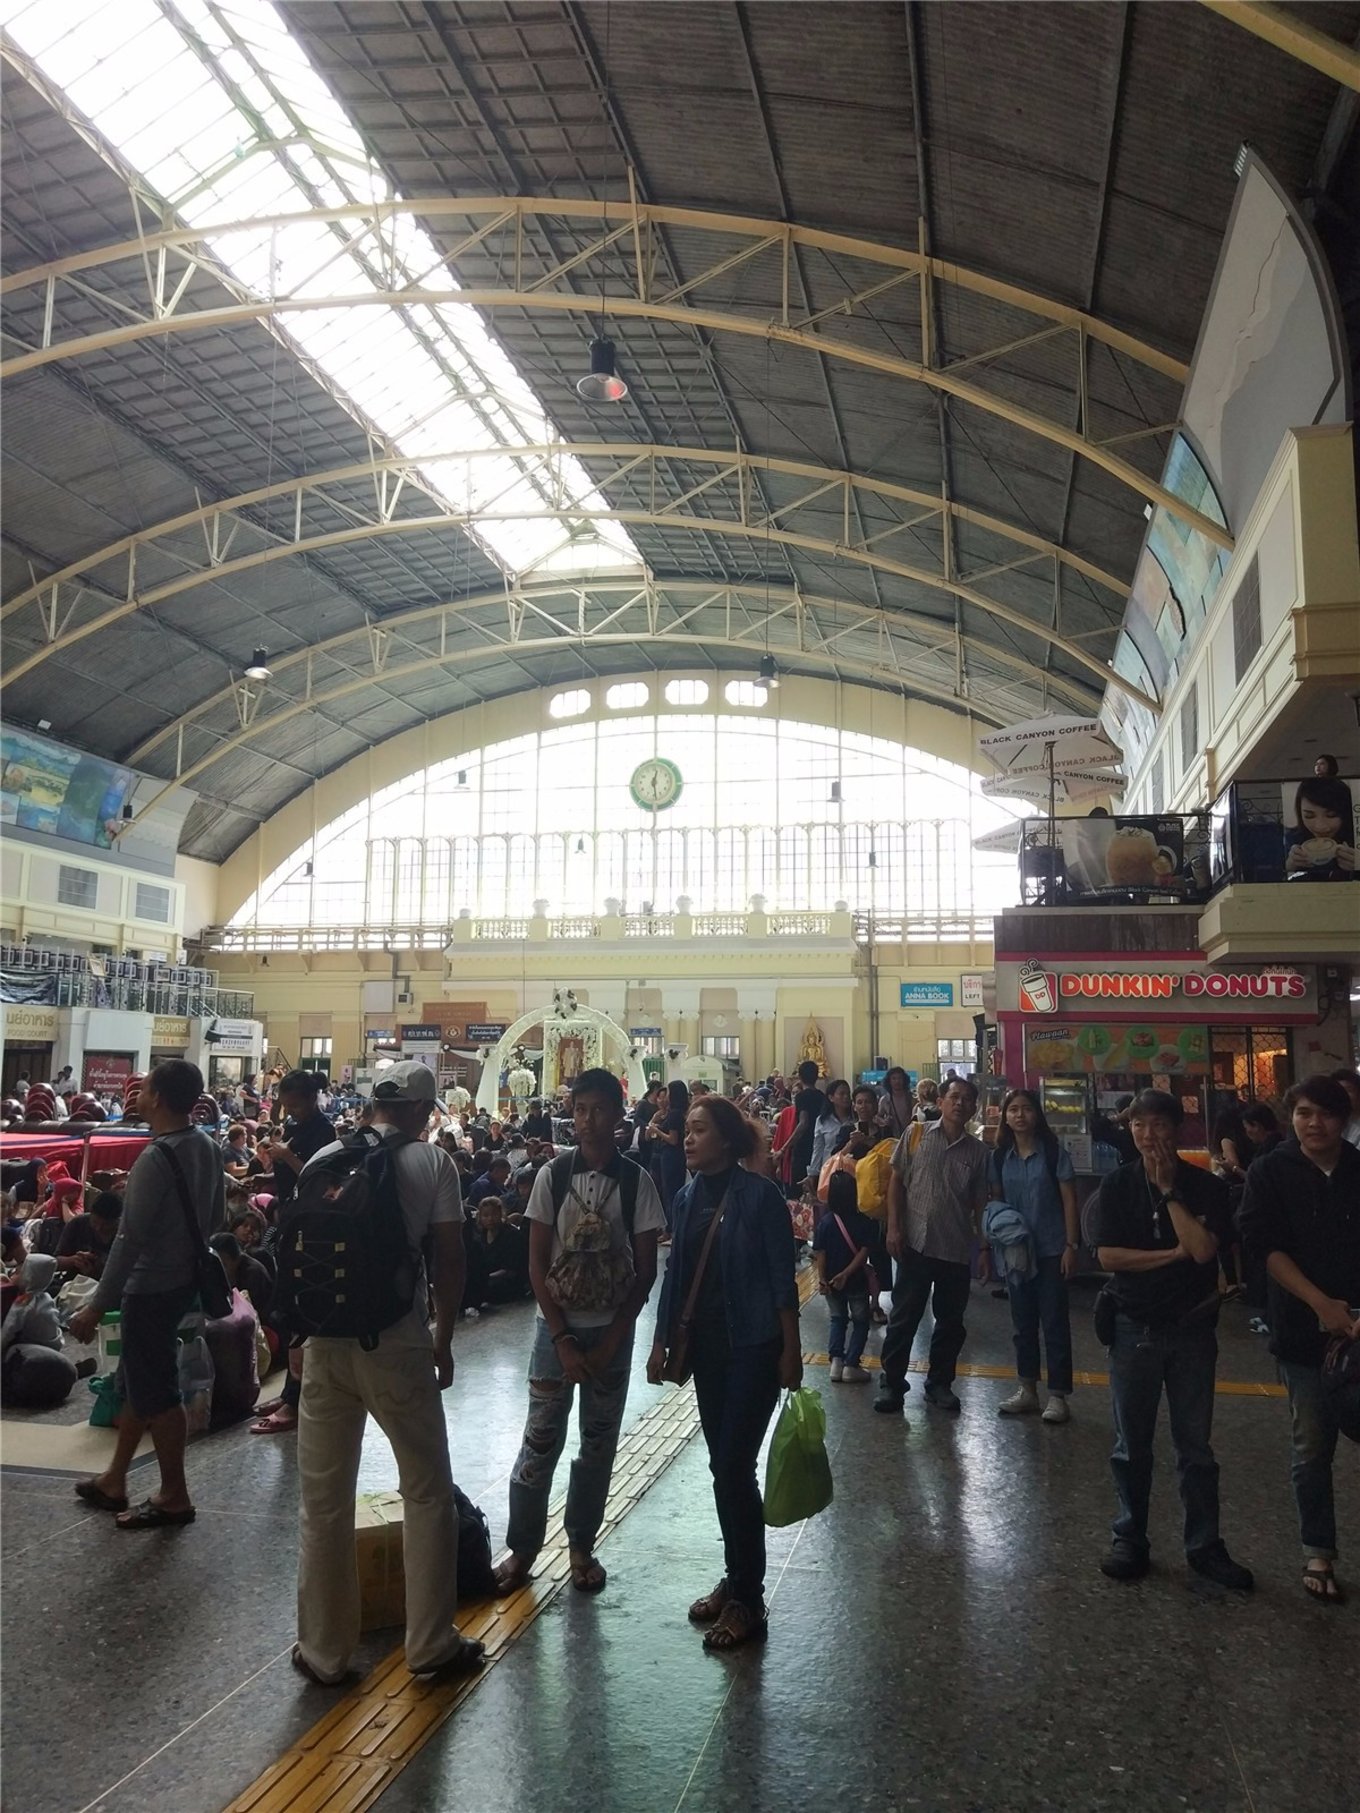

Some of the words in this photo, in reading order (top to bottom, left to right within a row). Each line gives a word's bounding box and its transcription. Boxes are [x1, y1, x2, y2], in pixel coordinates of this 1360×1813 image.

[980, 735, 1011, 745] BLACK
[1015, 729, 1055, 741] CANYON
[1058, 723, 1097, 735] COFFEE
[1063, 770, 1094, 780] CANYON
[1096, 775, 1124, 786] COFFEE
[1060, 973, 1180, 998] DUNKIN'
[1183, 973, 1306, 998] DONUTS
